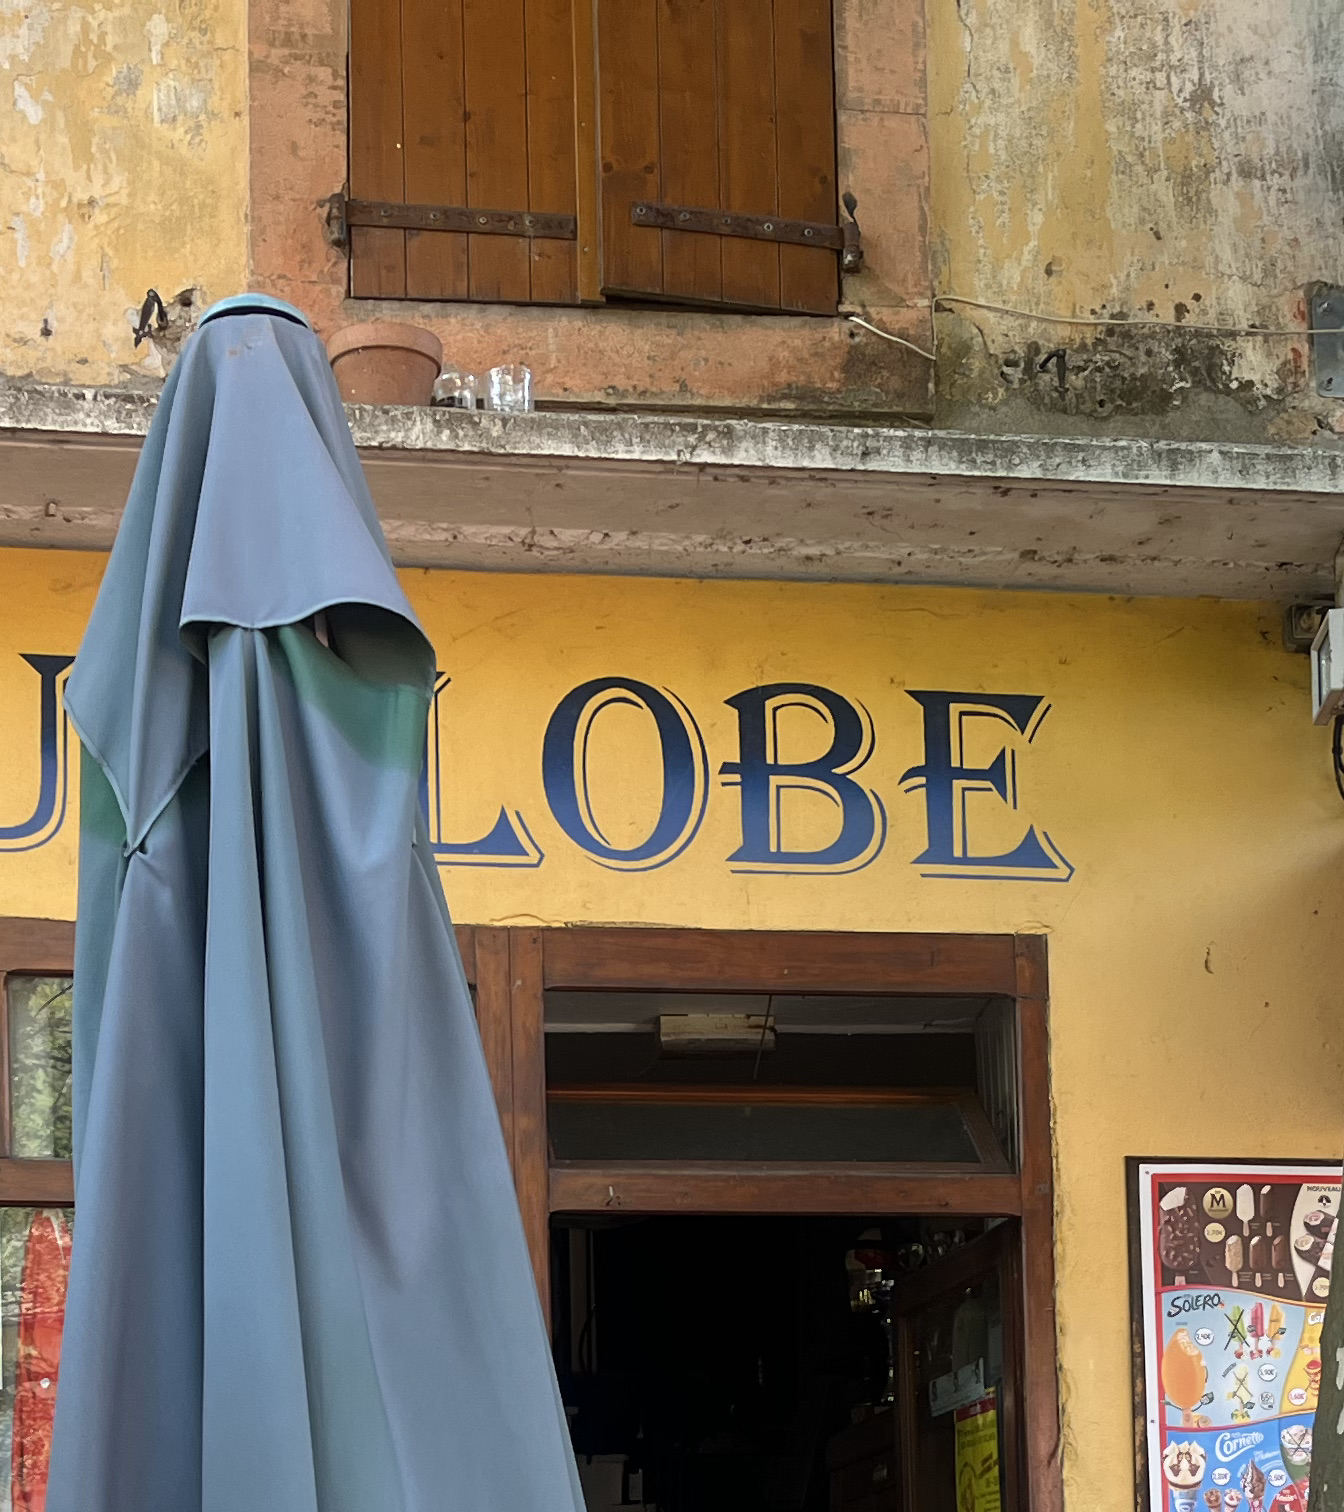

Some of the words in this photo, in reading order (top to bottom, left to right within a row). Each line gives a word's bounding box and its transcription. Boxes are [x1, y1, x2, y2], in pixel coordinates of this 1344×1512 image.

[423, 668, 1075, 882] LOBE
[1167, 1293, 1221, 1317] SOLERO
[1215, 1432, 1264, 1463] Cornetto
